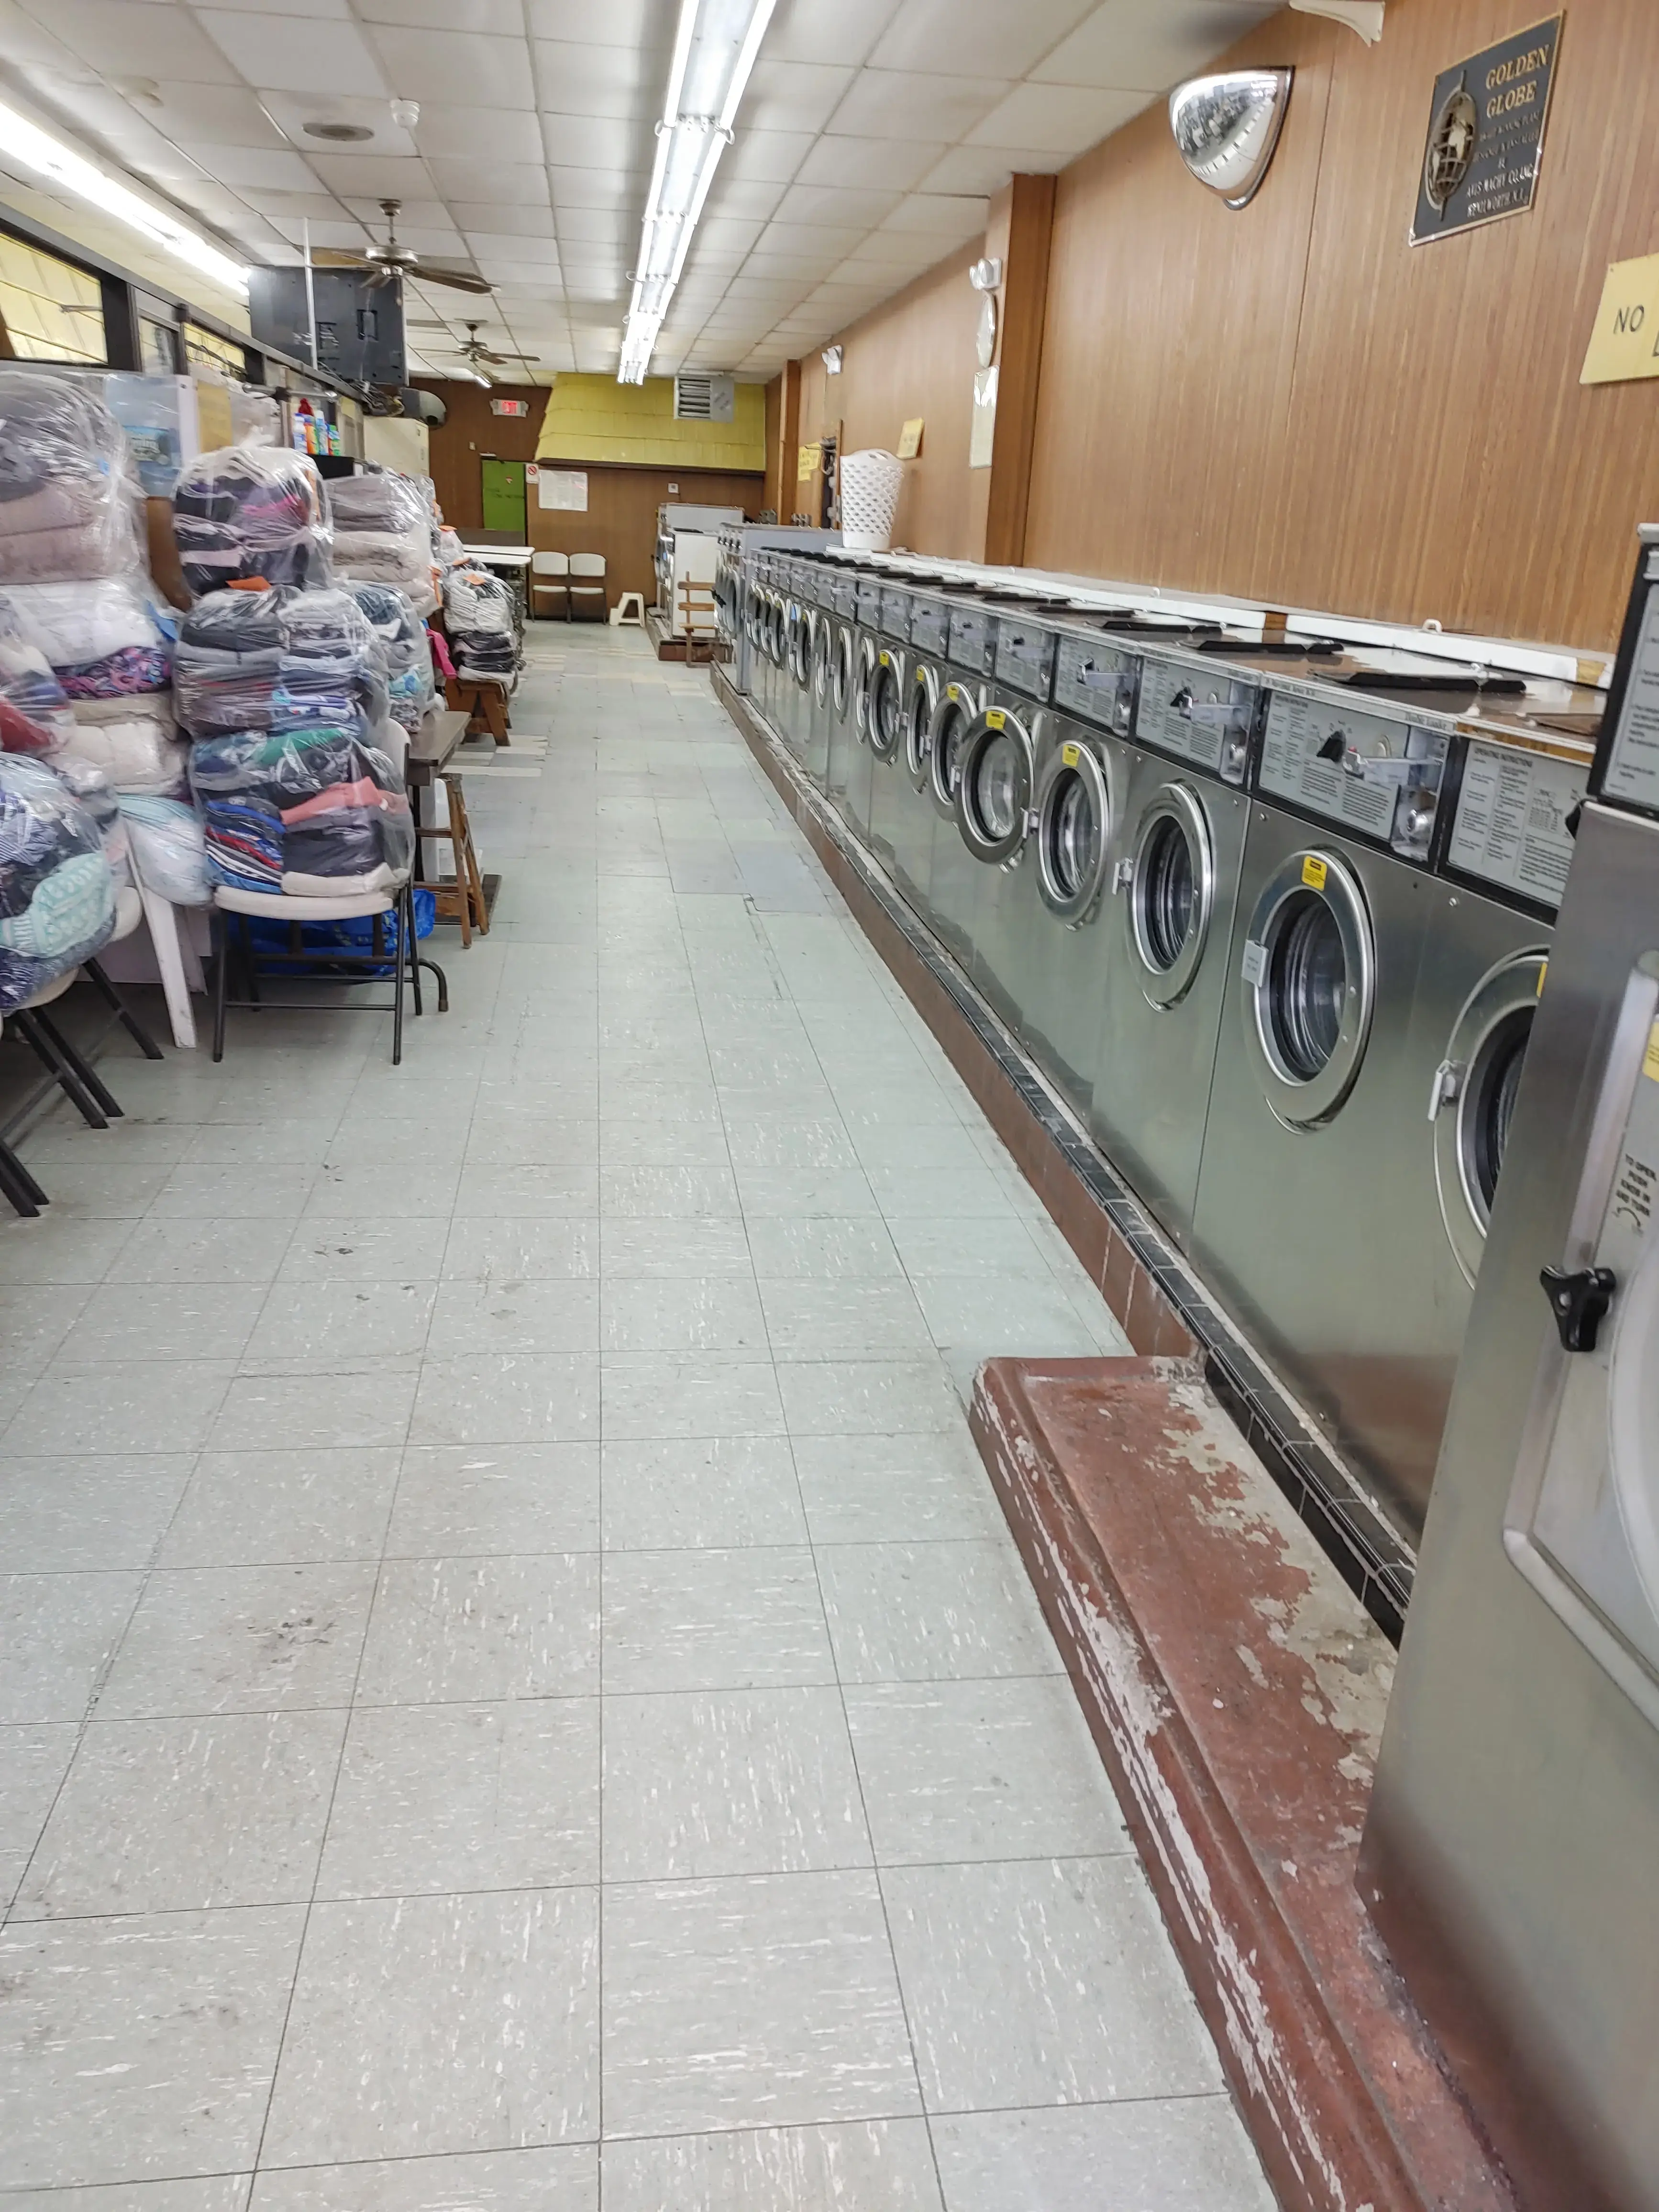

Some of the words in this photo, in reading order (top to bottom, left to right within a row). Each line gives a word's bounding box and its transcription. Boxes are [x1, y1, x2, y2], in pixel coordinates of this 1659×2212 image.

[1485, 44, 1550, 91] GOLDEN
[1486, 80, 1537, 119] GLOBE
[1614, 304, 1645, 334] NO
[1625, 1153, 1634, 1166] TO
